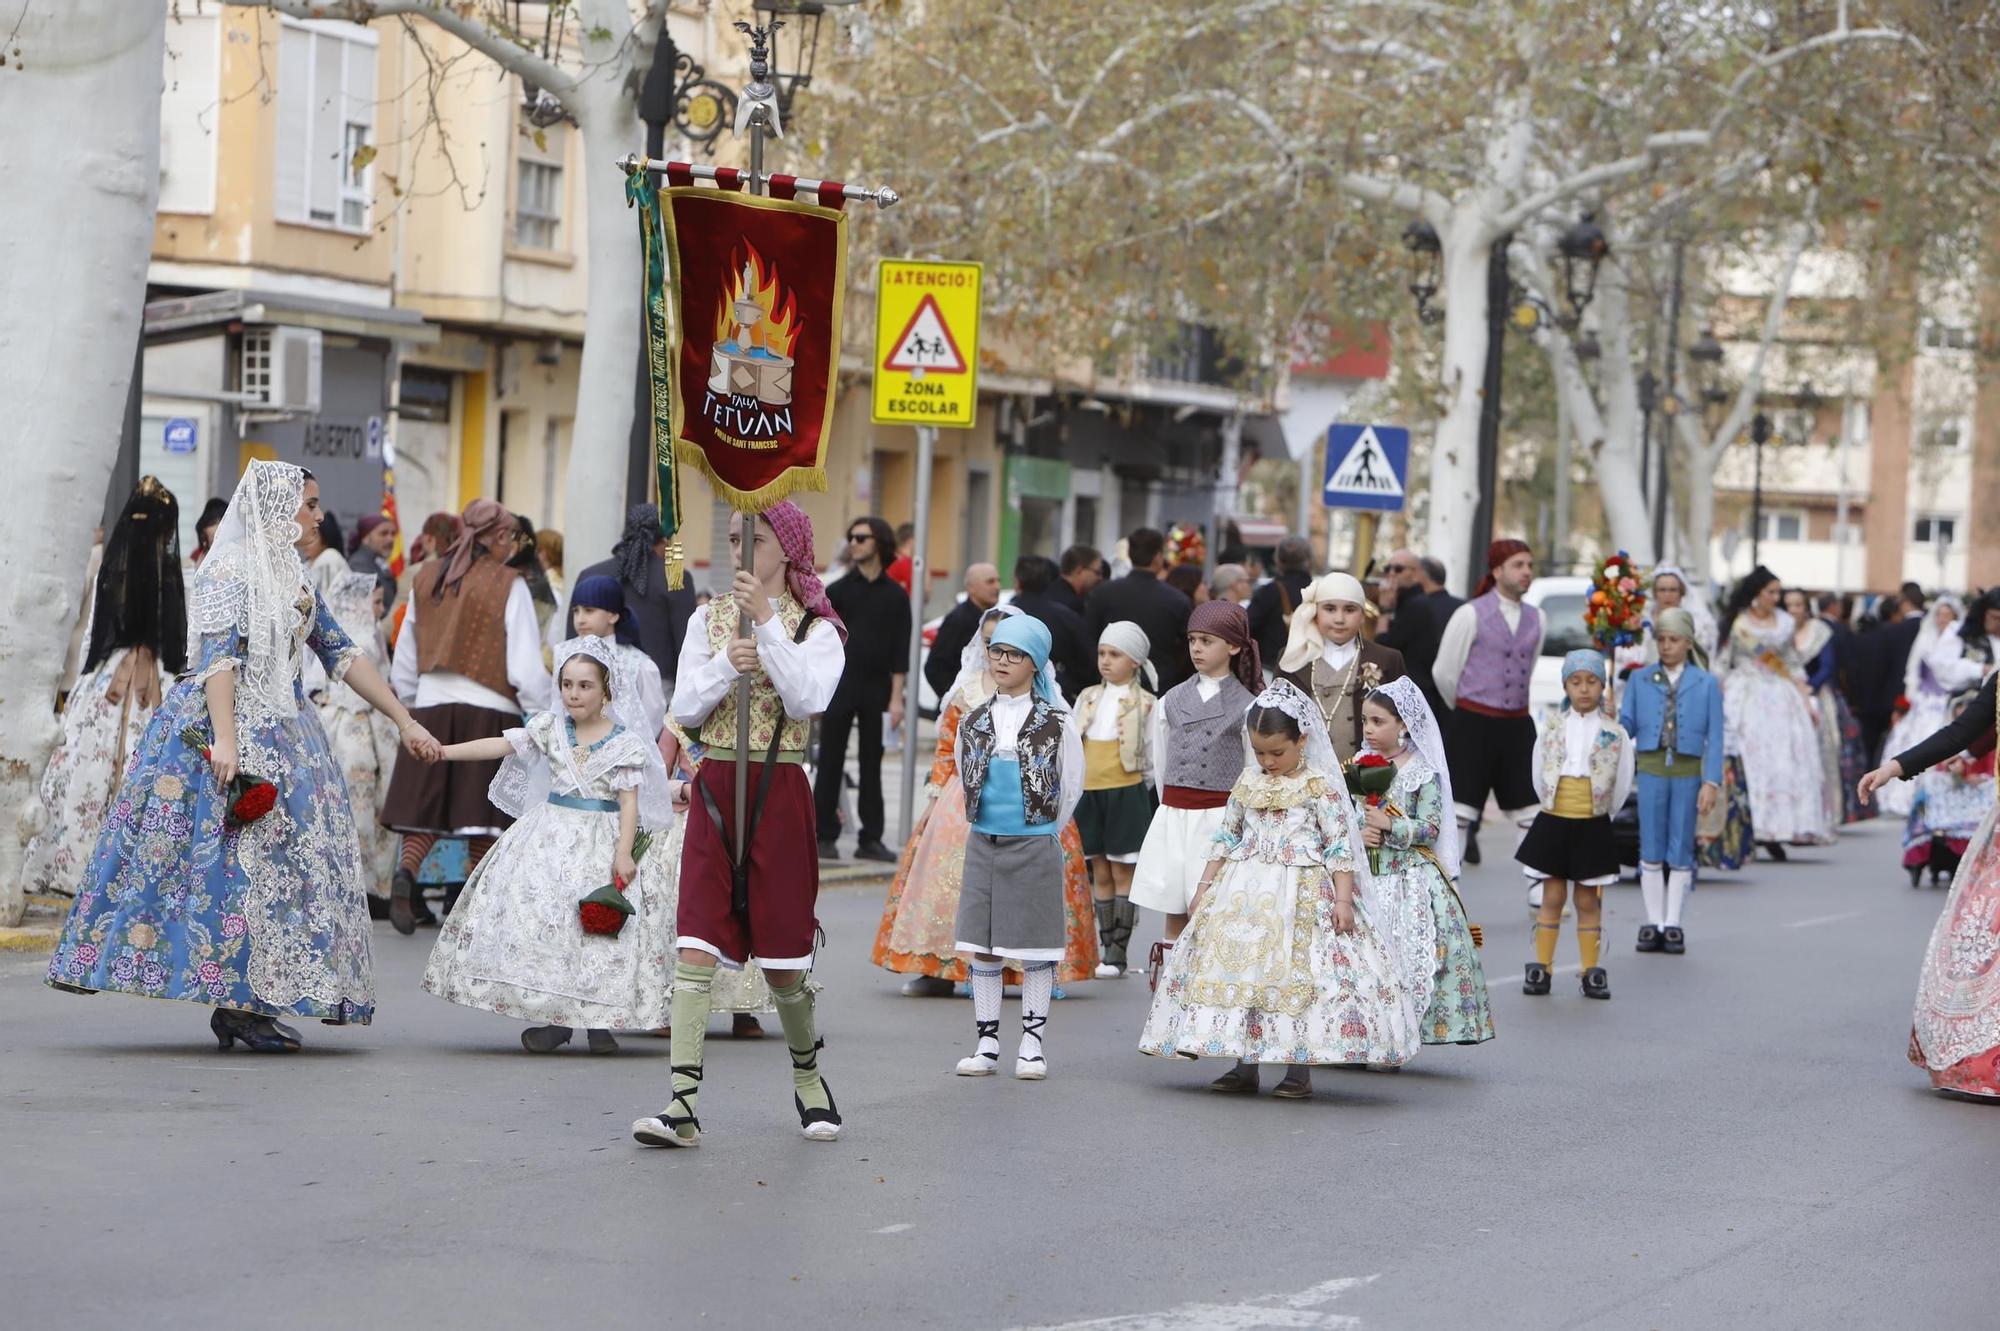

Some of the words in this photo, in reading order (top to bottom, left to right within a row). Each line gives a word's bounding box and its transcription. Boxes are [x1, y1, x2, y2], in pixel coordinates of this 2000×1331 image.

[655, 381, 668, 420] BURDEOS
[732, 394, 758, 410] FALLA
[904, 382, 945, 397] ZONA
[703, 391, 792, 436] TETUAN
[888, 399, 959, 415] ESCOLAR
[302, 423, 364, 459] ABIERTO
[656, 421, 671, 467] ELIZABETH
[732, 438, 747, 449] SANT
[747, 440, 778, 450] FRANCESC
